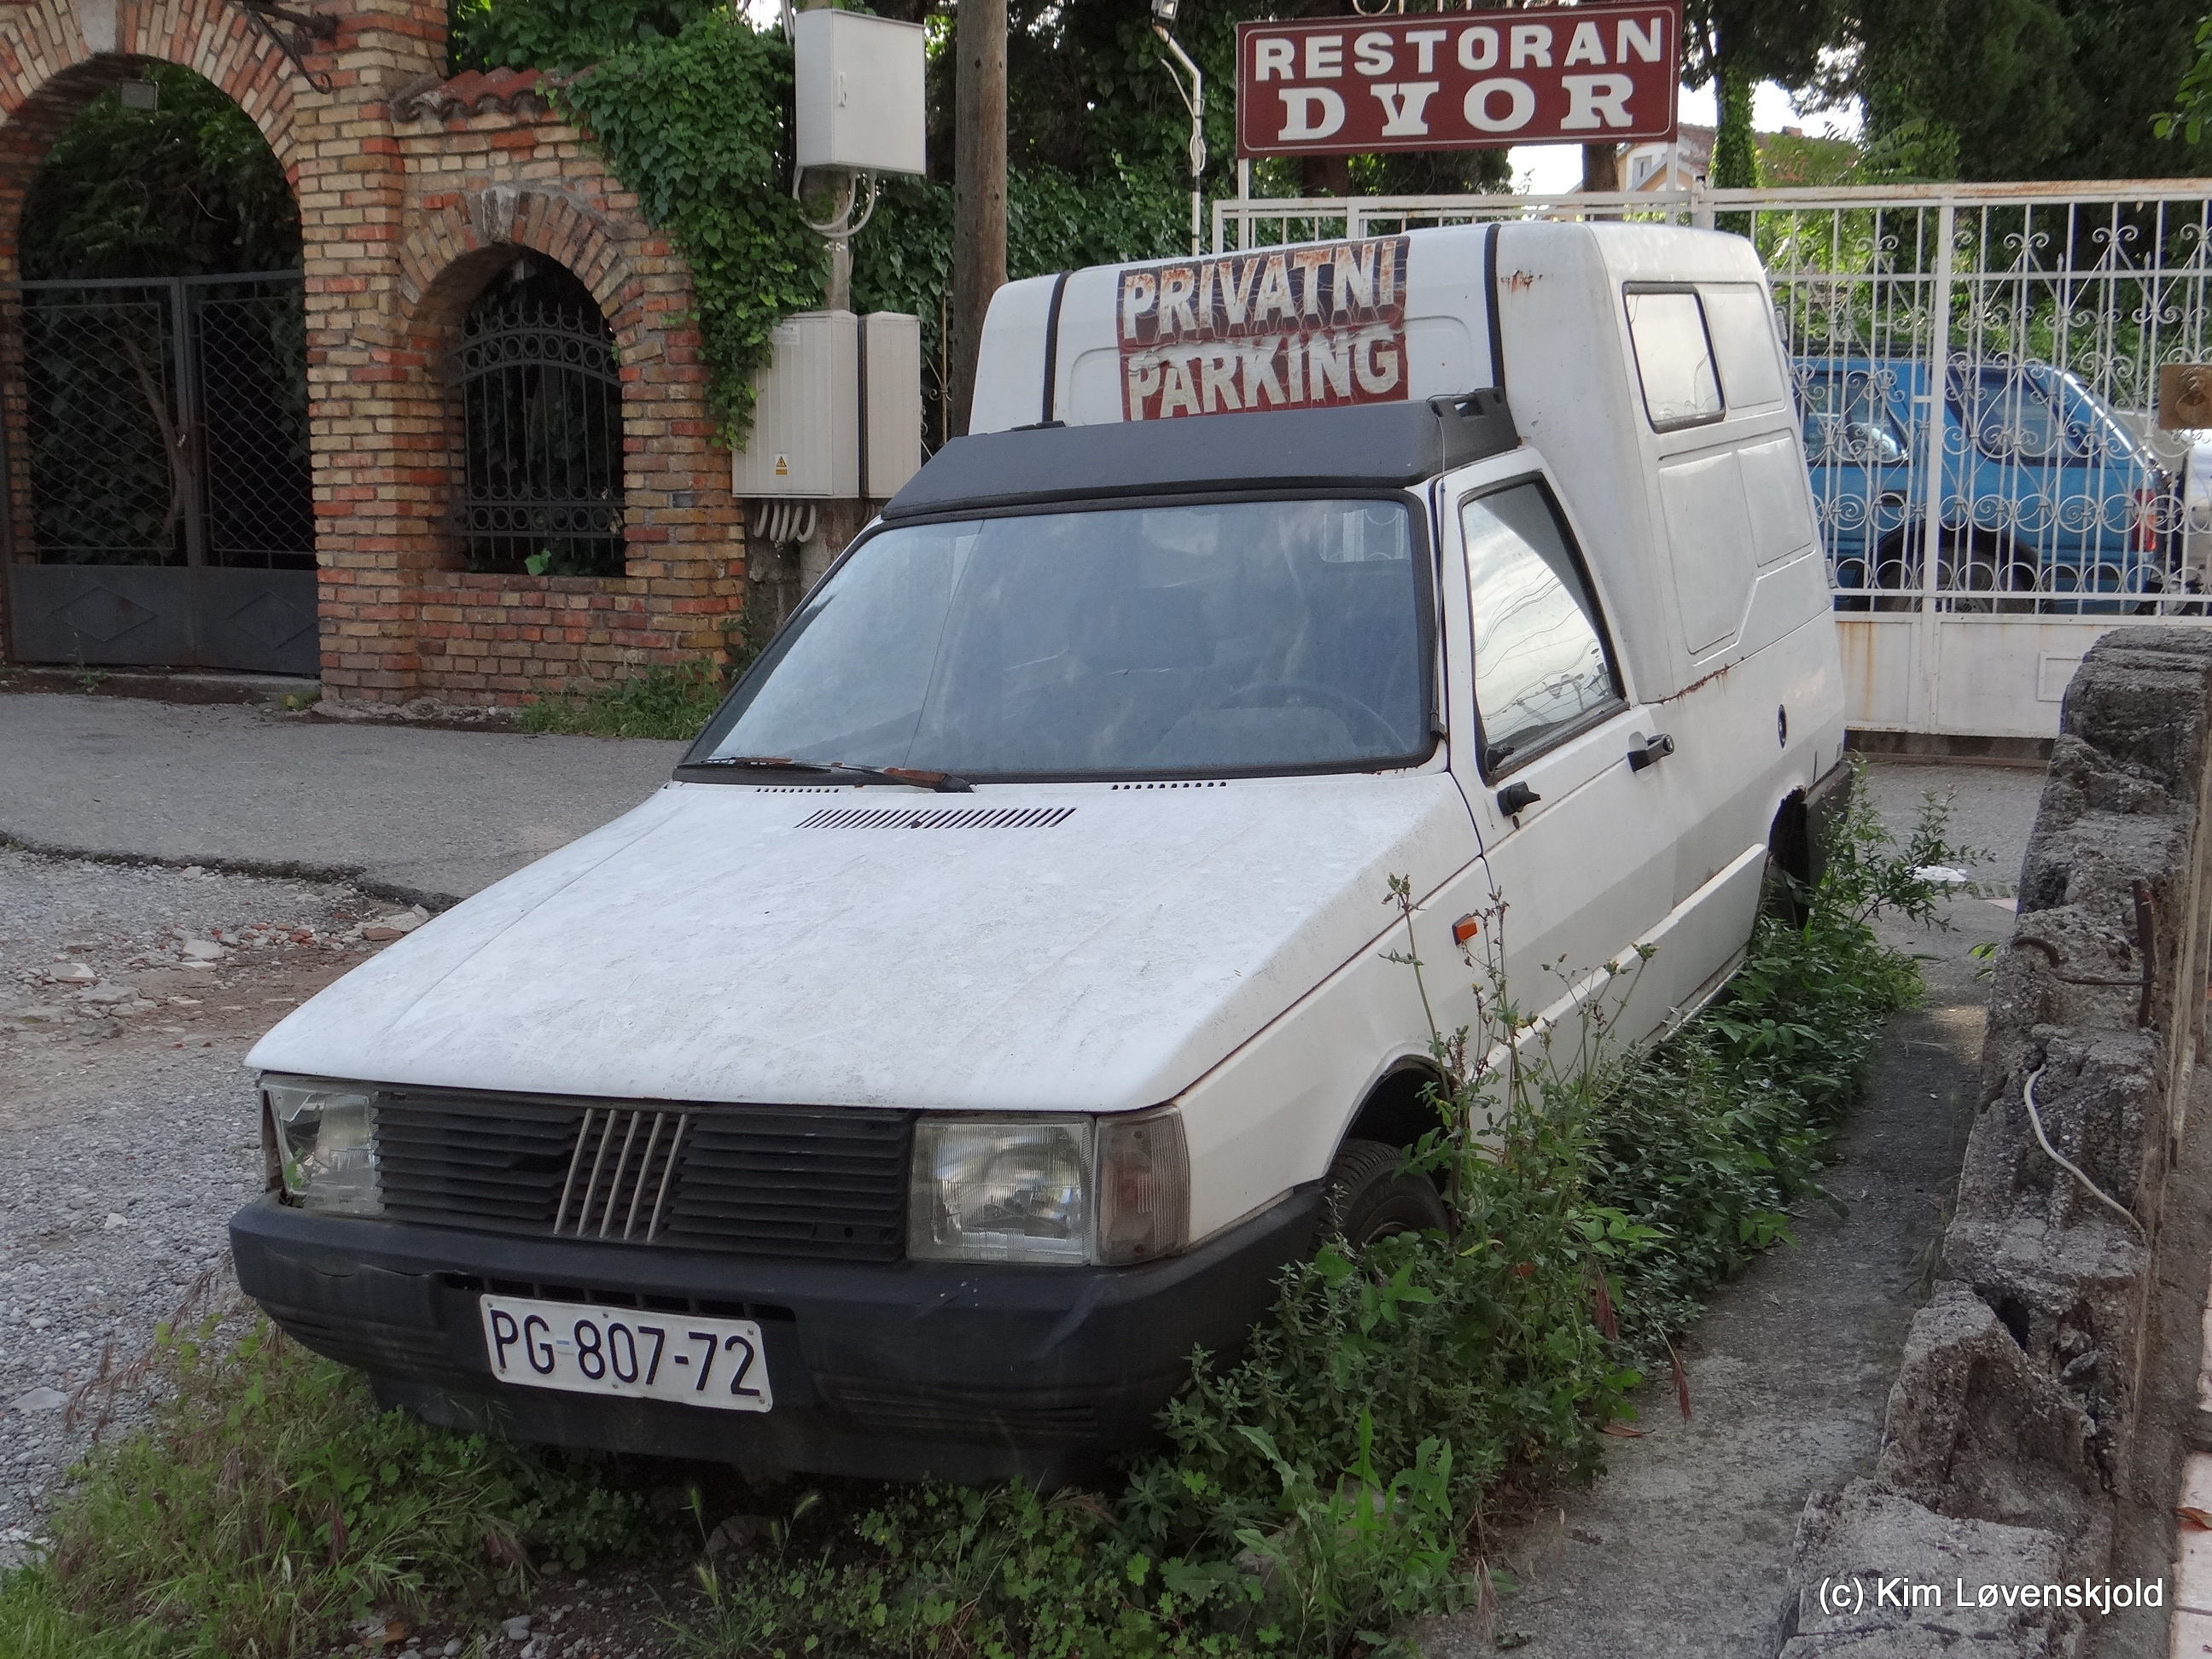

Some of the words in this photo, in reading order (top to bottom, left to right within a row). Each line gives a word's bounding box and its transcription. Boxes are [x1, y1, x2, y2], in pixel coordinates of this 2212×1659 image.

[1254, 17, 1662, 82] RESTORAN
[1278, 73, 1633, 142] DVOR
[1123, 241, 1397, 340] PRIVATNI
[1128, 335, 1399, 421] PARKING
